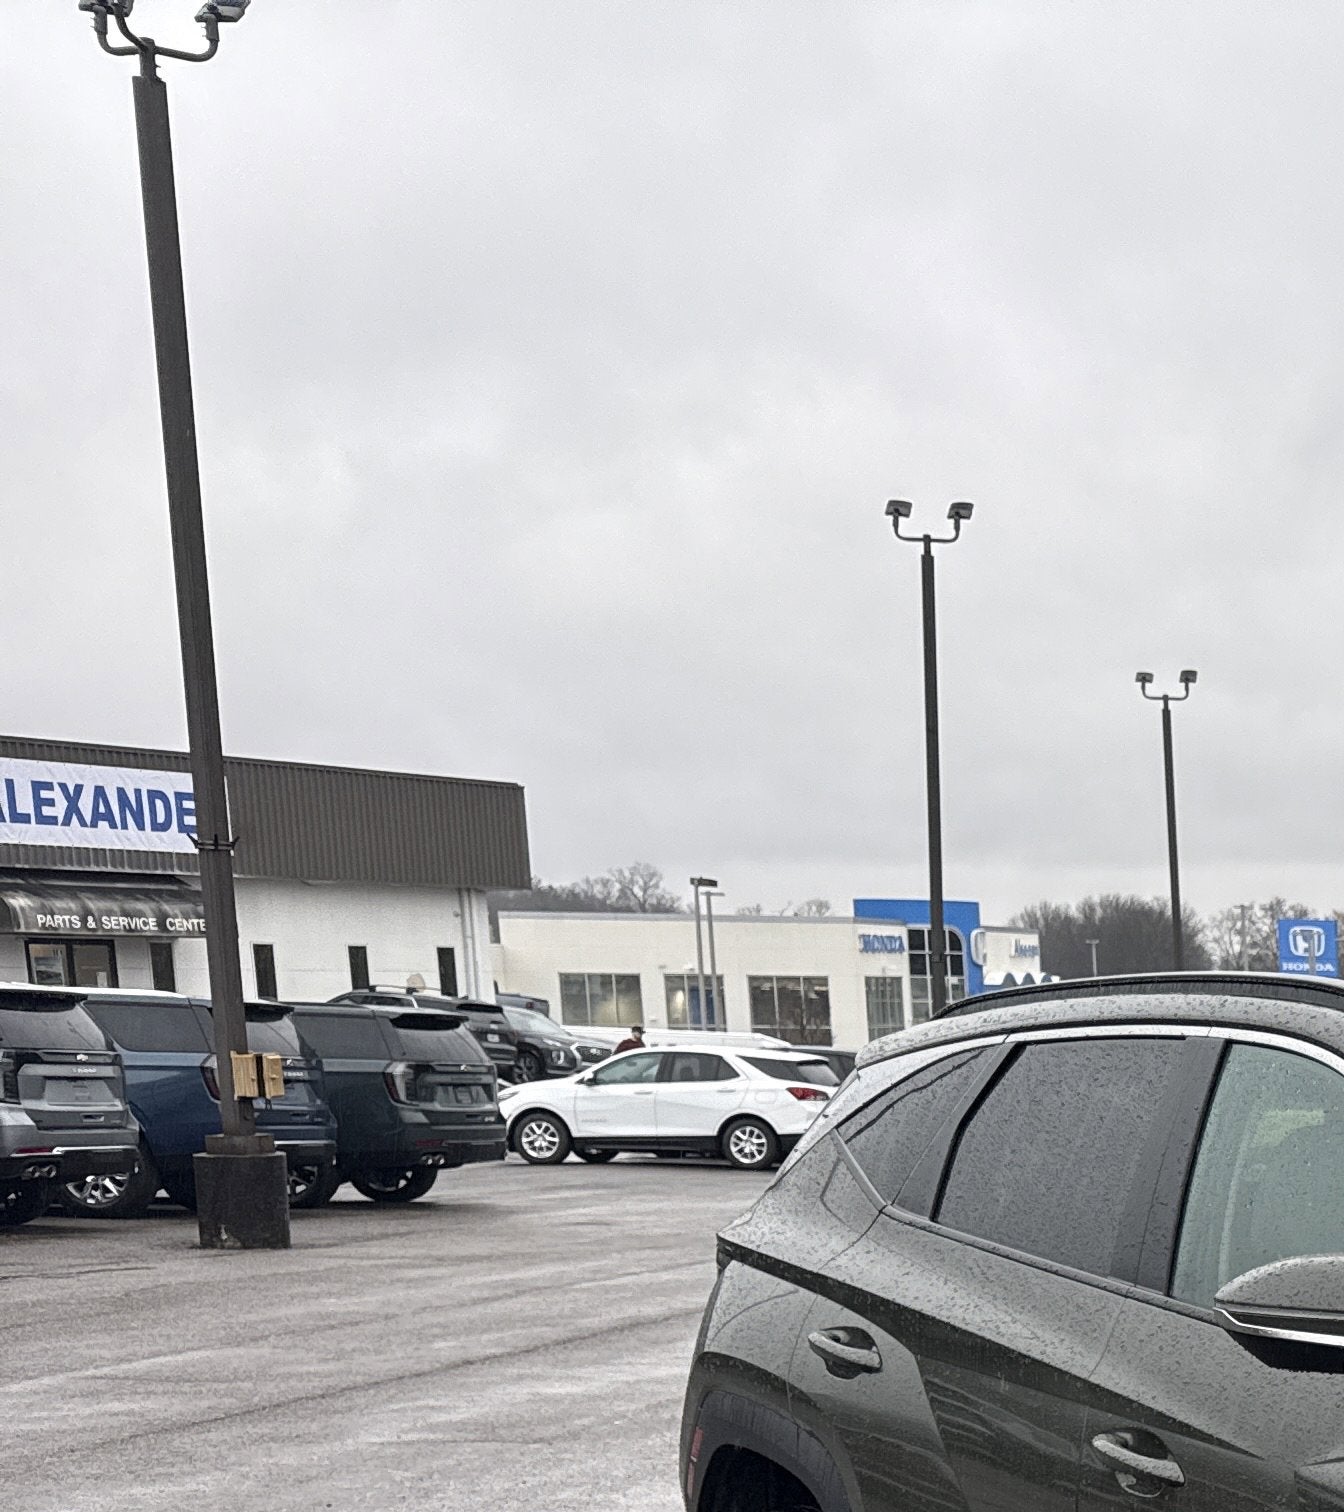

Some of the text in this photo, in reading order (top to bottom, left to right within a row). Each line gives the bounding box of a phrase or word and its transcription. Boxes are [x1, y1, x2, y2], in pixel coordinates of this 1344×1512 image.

[0, 777, 198, 834] LEXANDE
[36, 914, 206, 931] PARTS & SERVICE CENTE
